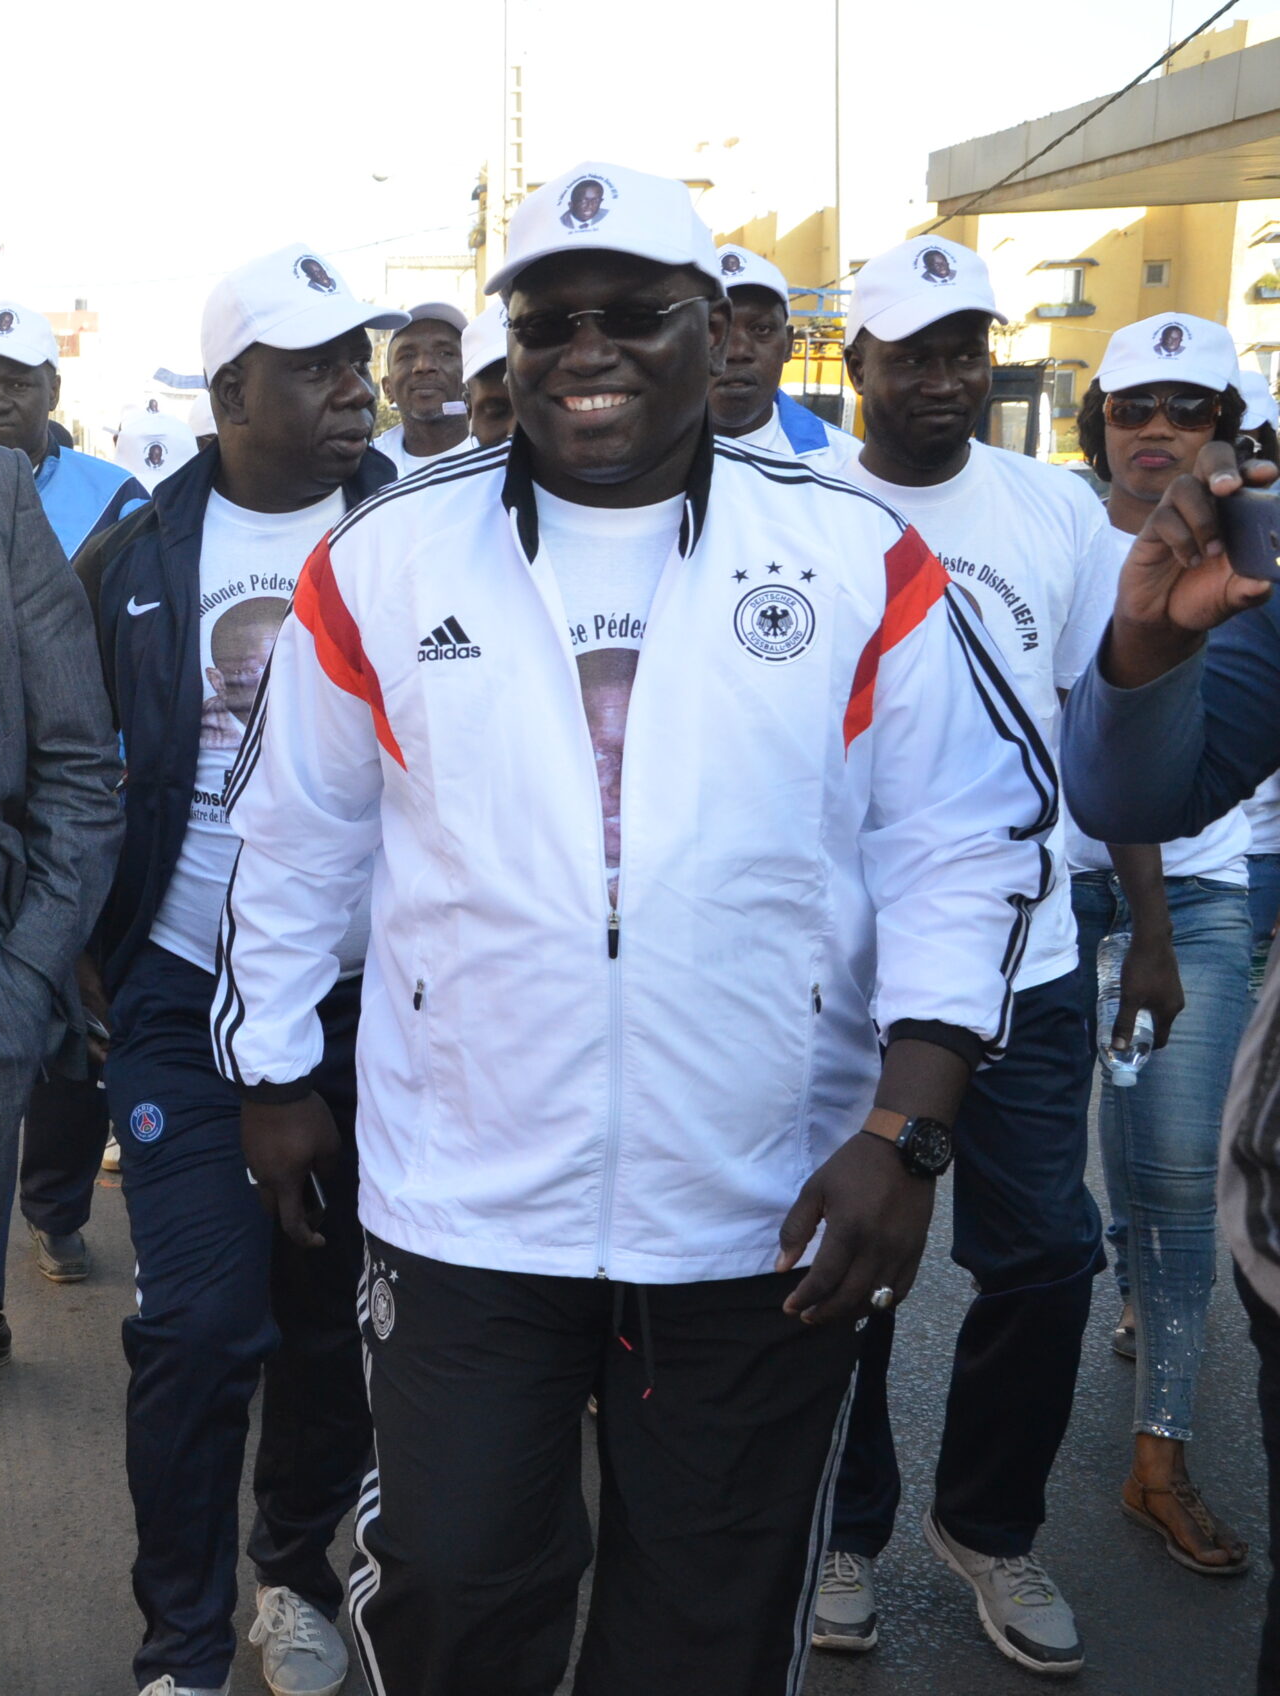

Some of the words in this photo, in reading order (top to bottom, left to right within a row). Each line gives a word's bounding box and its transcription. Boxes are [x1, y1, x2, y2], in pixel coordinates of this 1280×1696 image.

[749, 593, 797, 609] DEUTSCHER
[977, 564, 1022, 608] District
[1011, 603, 1039, 652] IEF/PA
[747, 630, 803, 652] FUSSBALL-BUND
[417, 643, 482, 662] adidas
